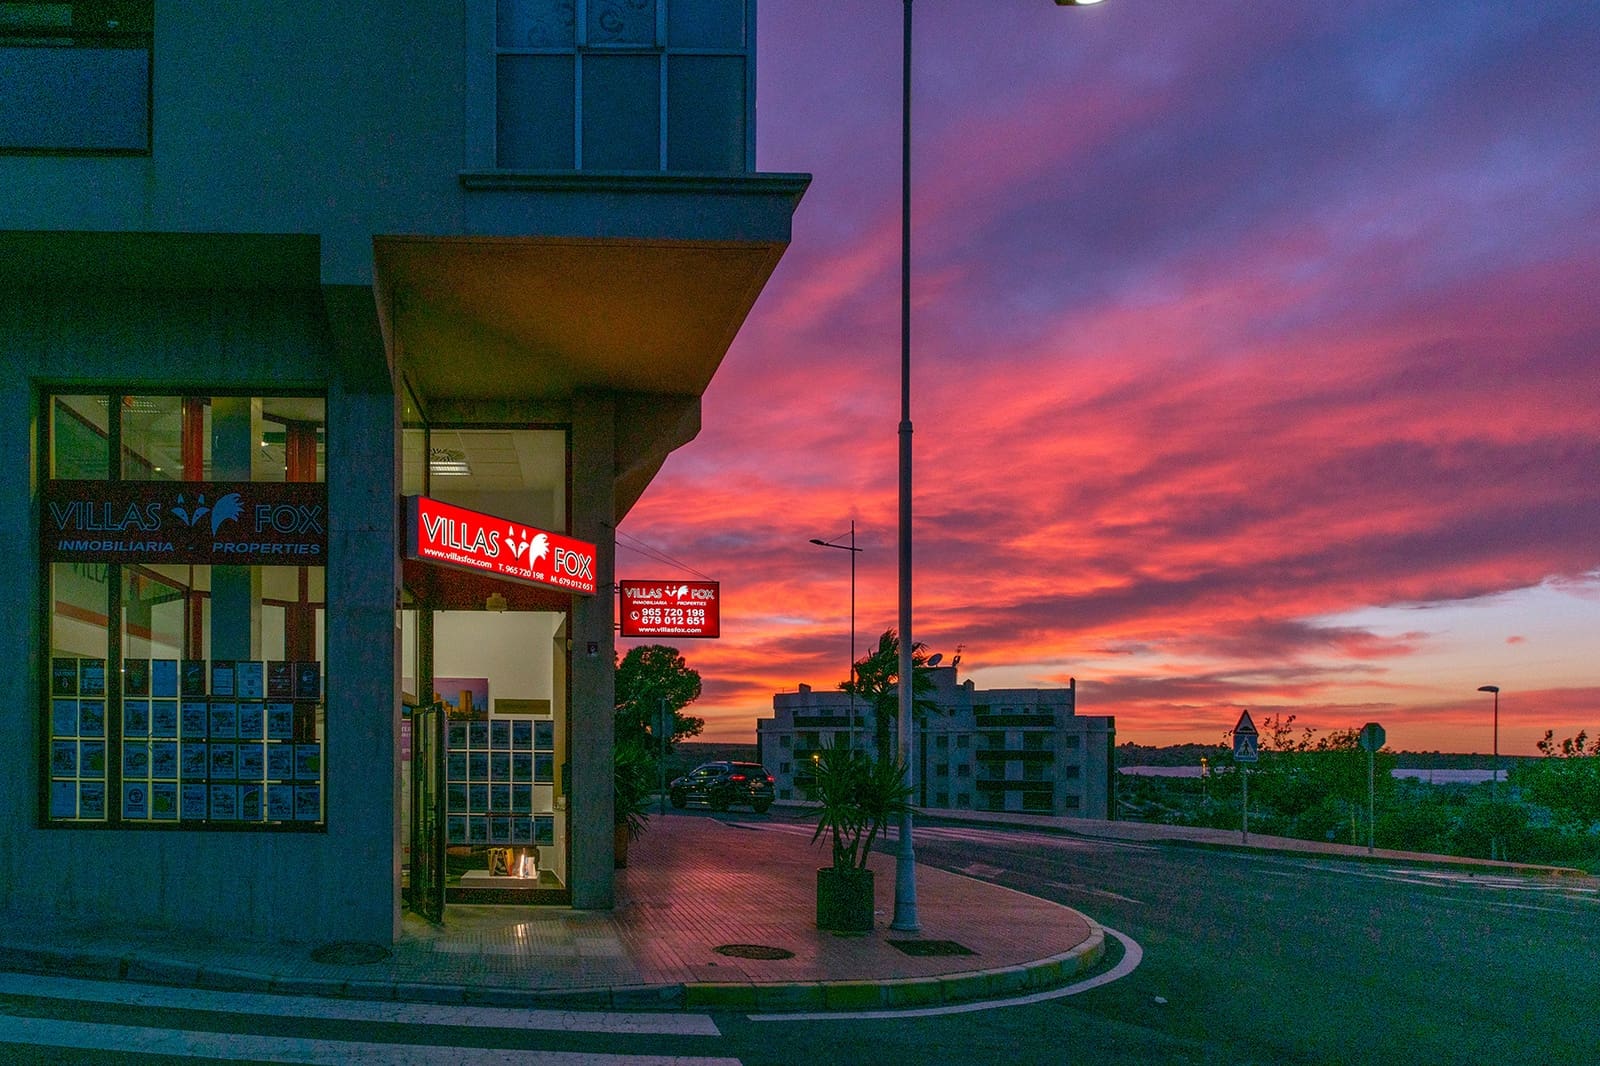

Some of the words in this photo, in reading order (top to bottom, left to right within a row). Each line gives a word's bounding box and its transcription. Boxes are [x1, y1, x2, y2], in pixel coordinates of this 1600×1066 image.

[48, 501, 161, 531] VILLAS
[255, 504, 323, 534] FOX
[58, 541, 174, 551] INMOBILIARIA
[212, 542, 321, 554] PROPERTIES
[421, 512, 500, 558] VILLAS
[554, 547, 593, 580] FOX
[423, 547, 493, 569] www.villasfox.com
[497, 563, 505, 572] T.
[505, 565, 518, 574] 965
[519, 568, 532, 577] 720
[532, 571, 545, 580] 198
[558, 577, 571, 585] 679
[571, 580, 583, 589] 012
[582, 583, 593, 591] 651
[624, 588, 662, 599] VILLAS
[691, 589, 715, 600] FOX
[641, 608, 661, 616] 965
[664, 608, 683, 616] 720
[686, 609, 705, 617] 198
[641, 616, 662, 625] 679
[664, 616, 684, 625] 012
[686, 617, 705, 625] 651
